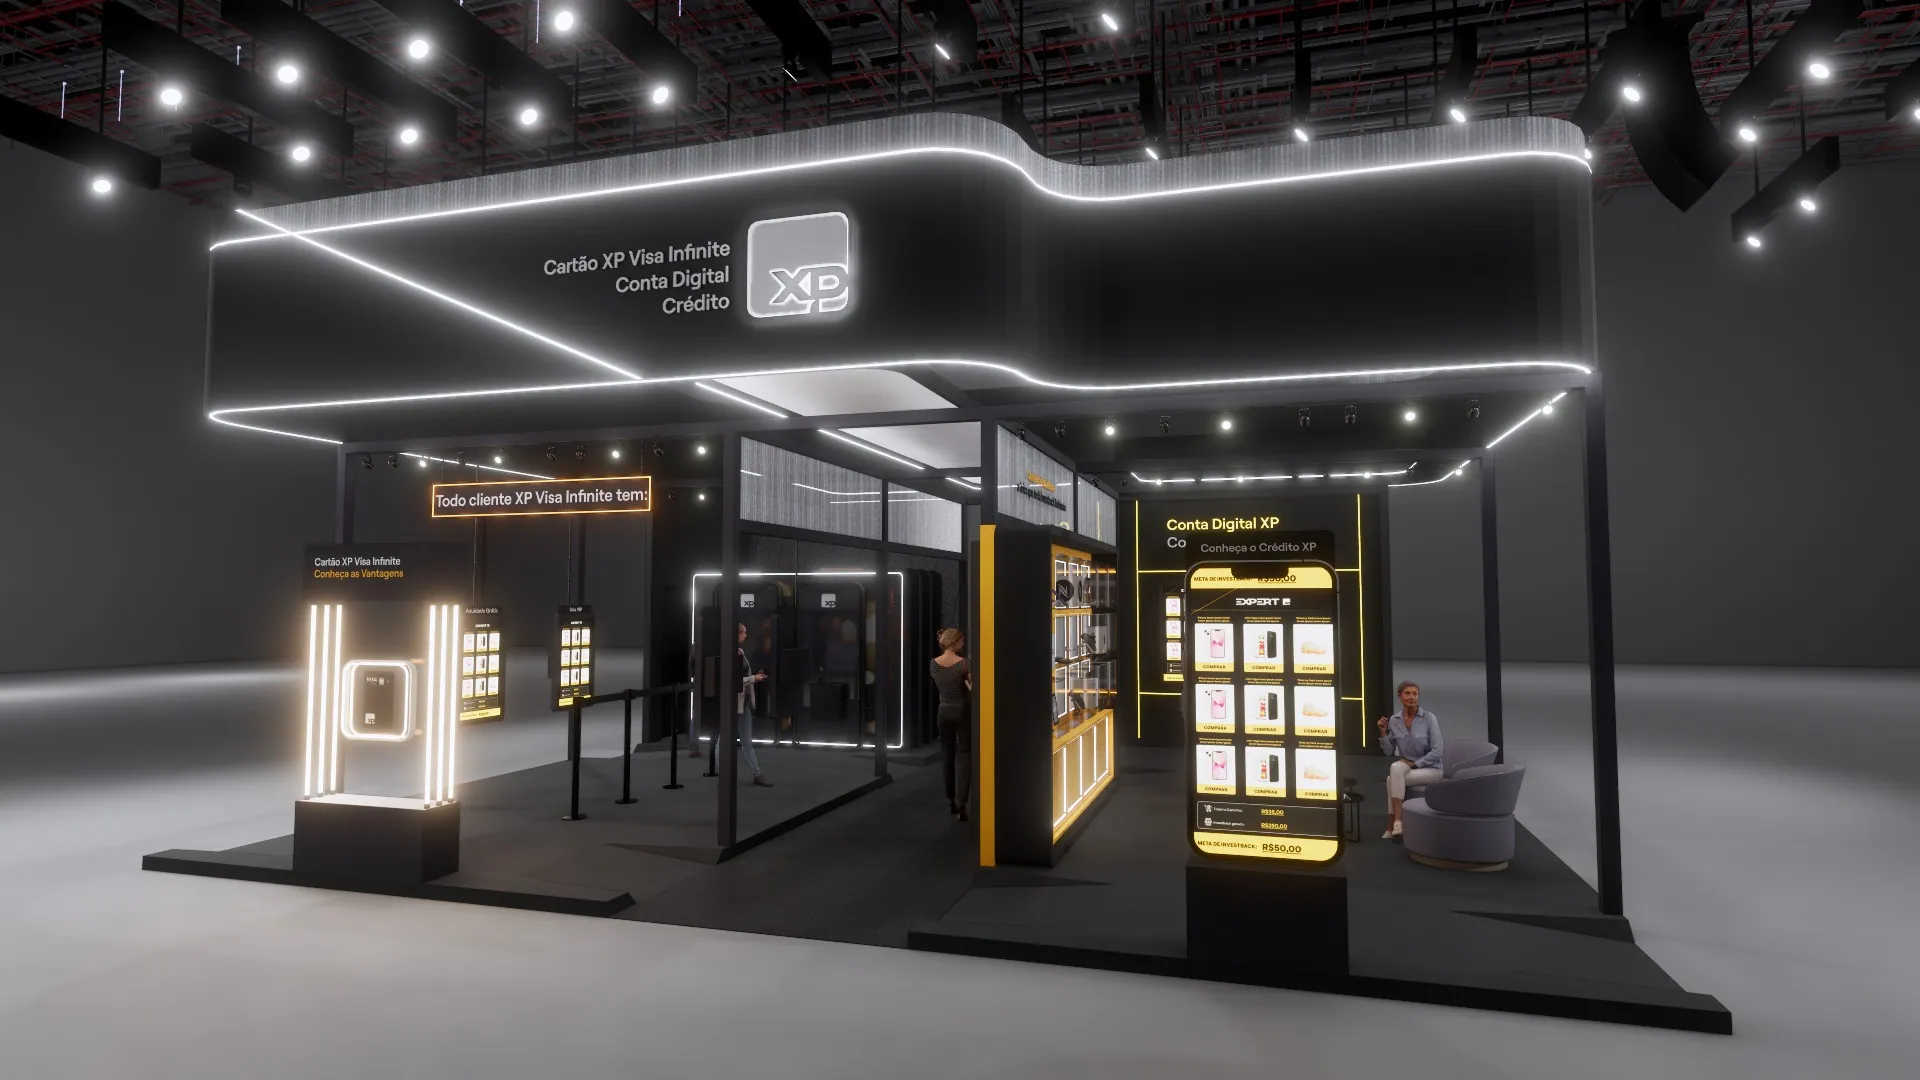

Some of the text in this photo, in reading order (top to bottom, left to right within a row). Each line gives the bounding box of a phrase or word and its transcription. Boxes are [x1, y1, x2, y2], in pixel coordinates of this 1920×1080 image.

[544, 241, 730, 275] Cartão XP Visa Infinite
[616, 265, 729, 293] Conta Digital
[769, 264, 849, 313] XP
[662, 294, 730, 314] Crédito
[436, 488, 648, 508] Todo cliente XP Visa Infinite tem:
[1166, 517, 1280, 533] Conta Digital XP
[1200, 543, 1248, 554] Conheça
[1259, 542, 1300, 552] Crédito
[1302, 542, 1317, 552] XP
[314, 556, 401, 567] Cartão XP Visa Infinite
[314, 569, 349, 580] Conheça
[361, 569, 404, 579] Vantagens
[1235, 597, 1280, 606] EXPERT
[1262, 843, 1302, 853] R$50,00
